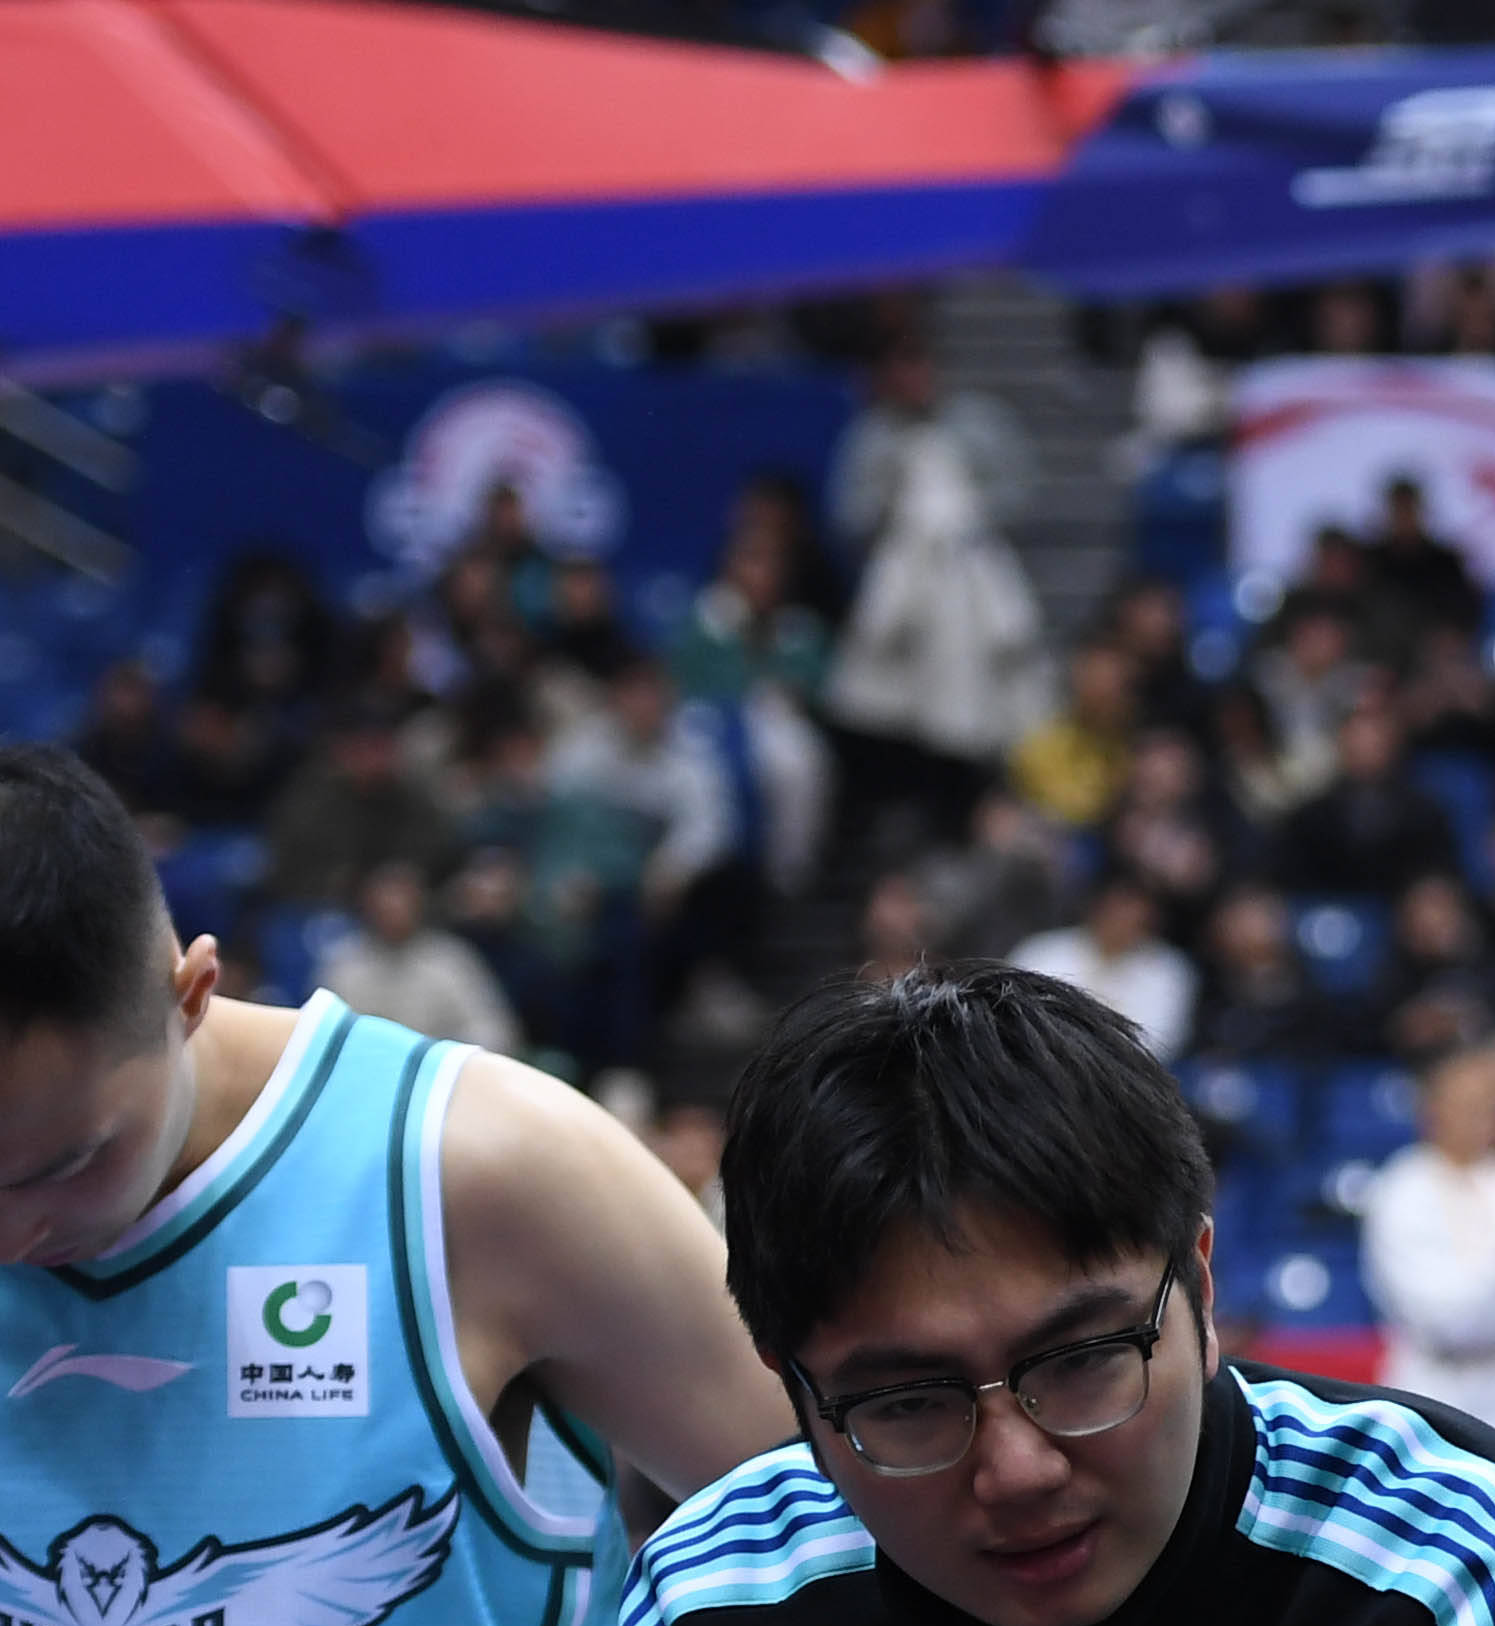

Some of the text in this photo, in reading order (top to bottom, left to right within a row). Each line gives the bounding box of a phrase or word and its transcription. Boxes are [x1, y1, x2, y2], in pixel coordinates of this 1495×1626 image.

[240, 1363, 355, 1385] 中国人寿
[240, 1389, 353, 1402] CHINA LIFE
